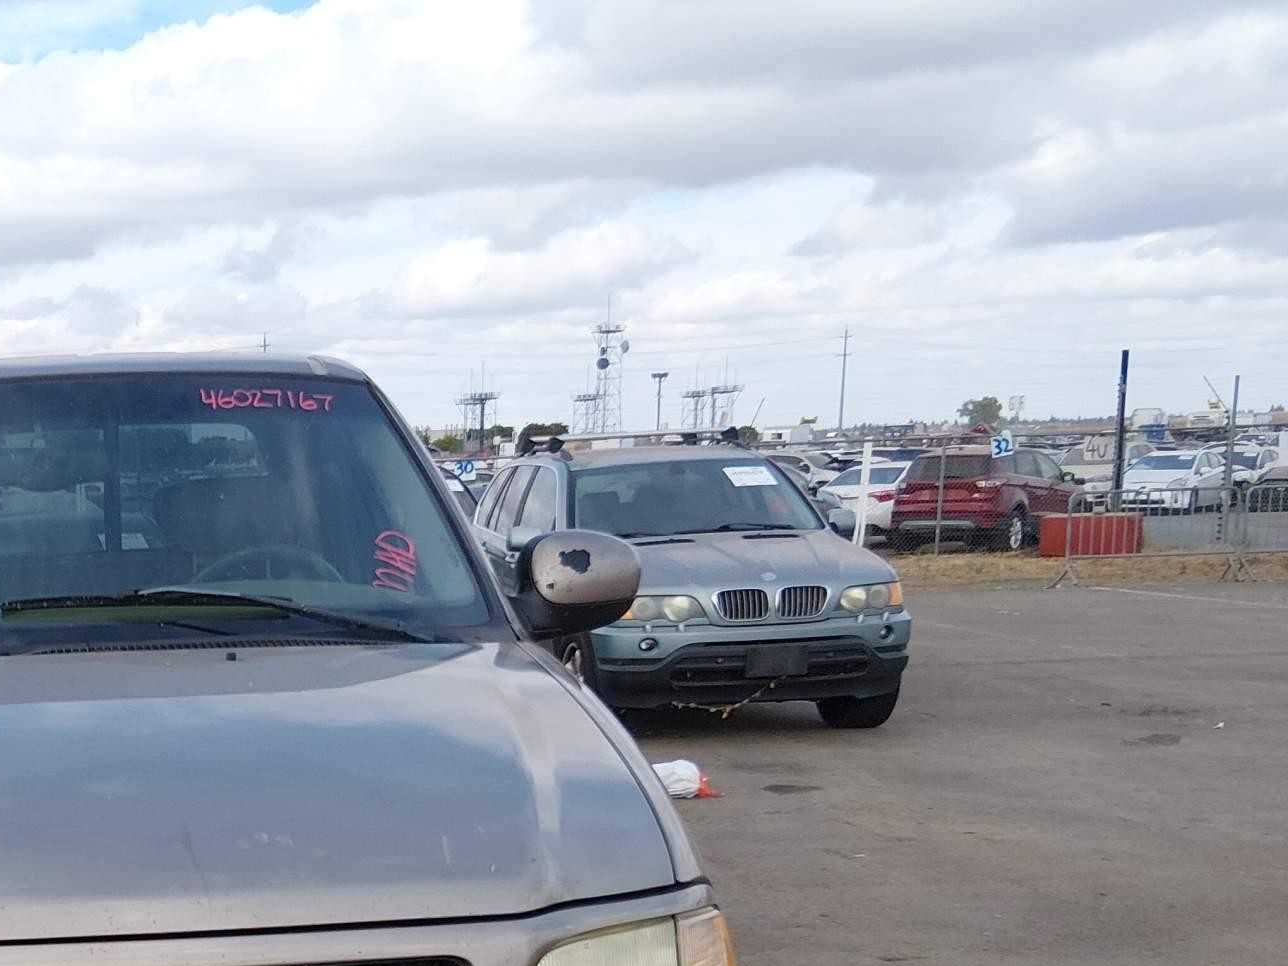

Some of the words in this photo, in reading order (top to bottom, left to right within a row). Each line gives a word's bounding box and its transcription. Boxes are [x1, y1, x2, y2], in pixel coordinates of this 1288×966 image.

[200, 389, 333, 411] 46027167
[993, 438, 1013, 455] 32
[455, 461, 474, 477] 30
